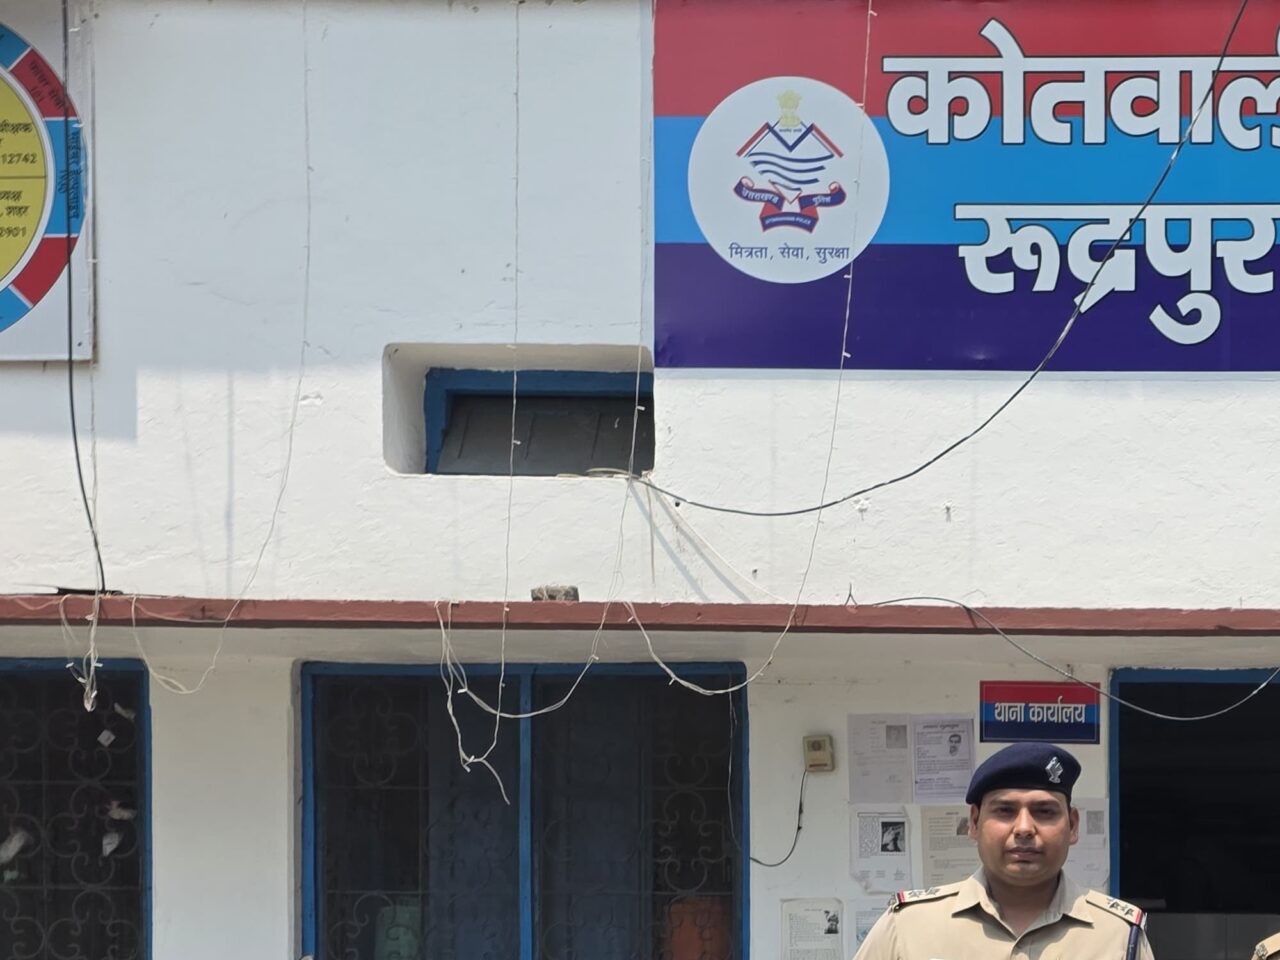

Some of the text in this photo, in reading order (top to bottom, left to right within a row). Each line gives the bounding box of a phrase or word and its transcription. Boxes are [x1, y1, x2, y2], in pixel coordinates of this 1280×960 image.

[814, 246, 850, 264] सुरक्षा
[994, 695, 1086, 724] थाना कार्यालय
